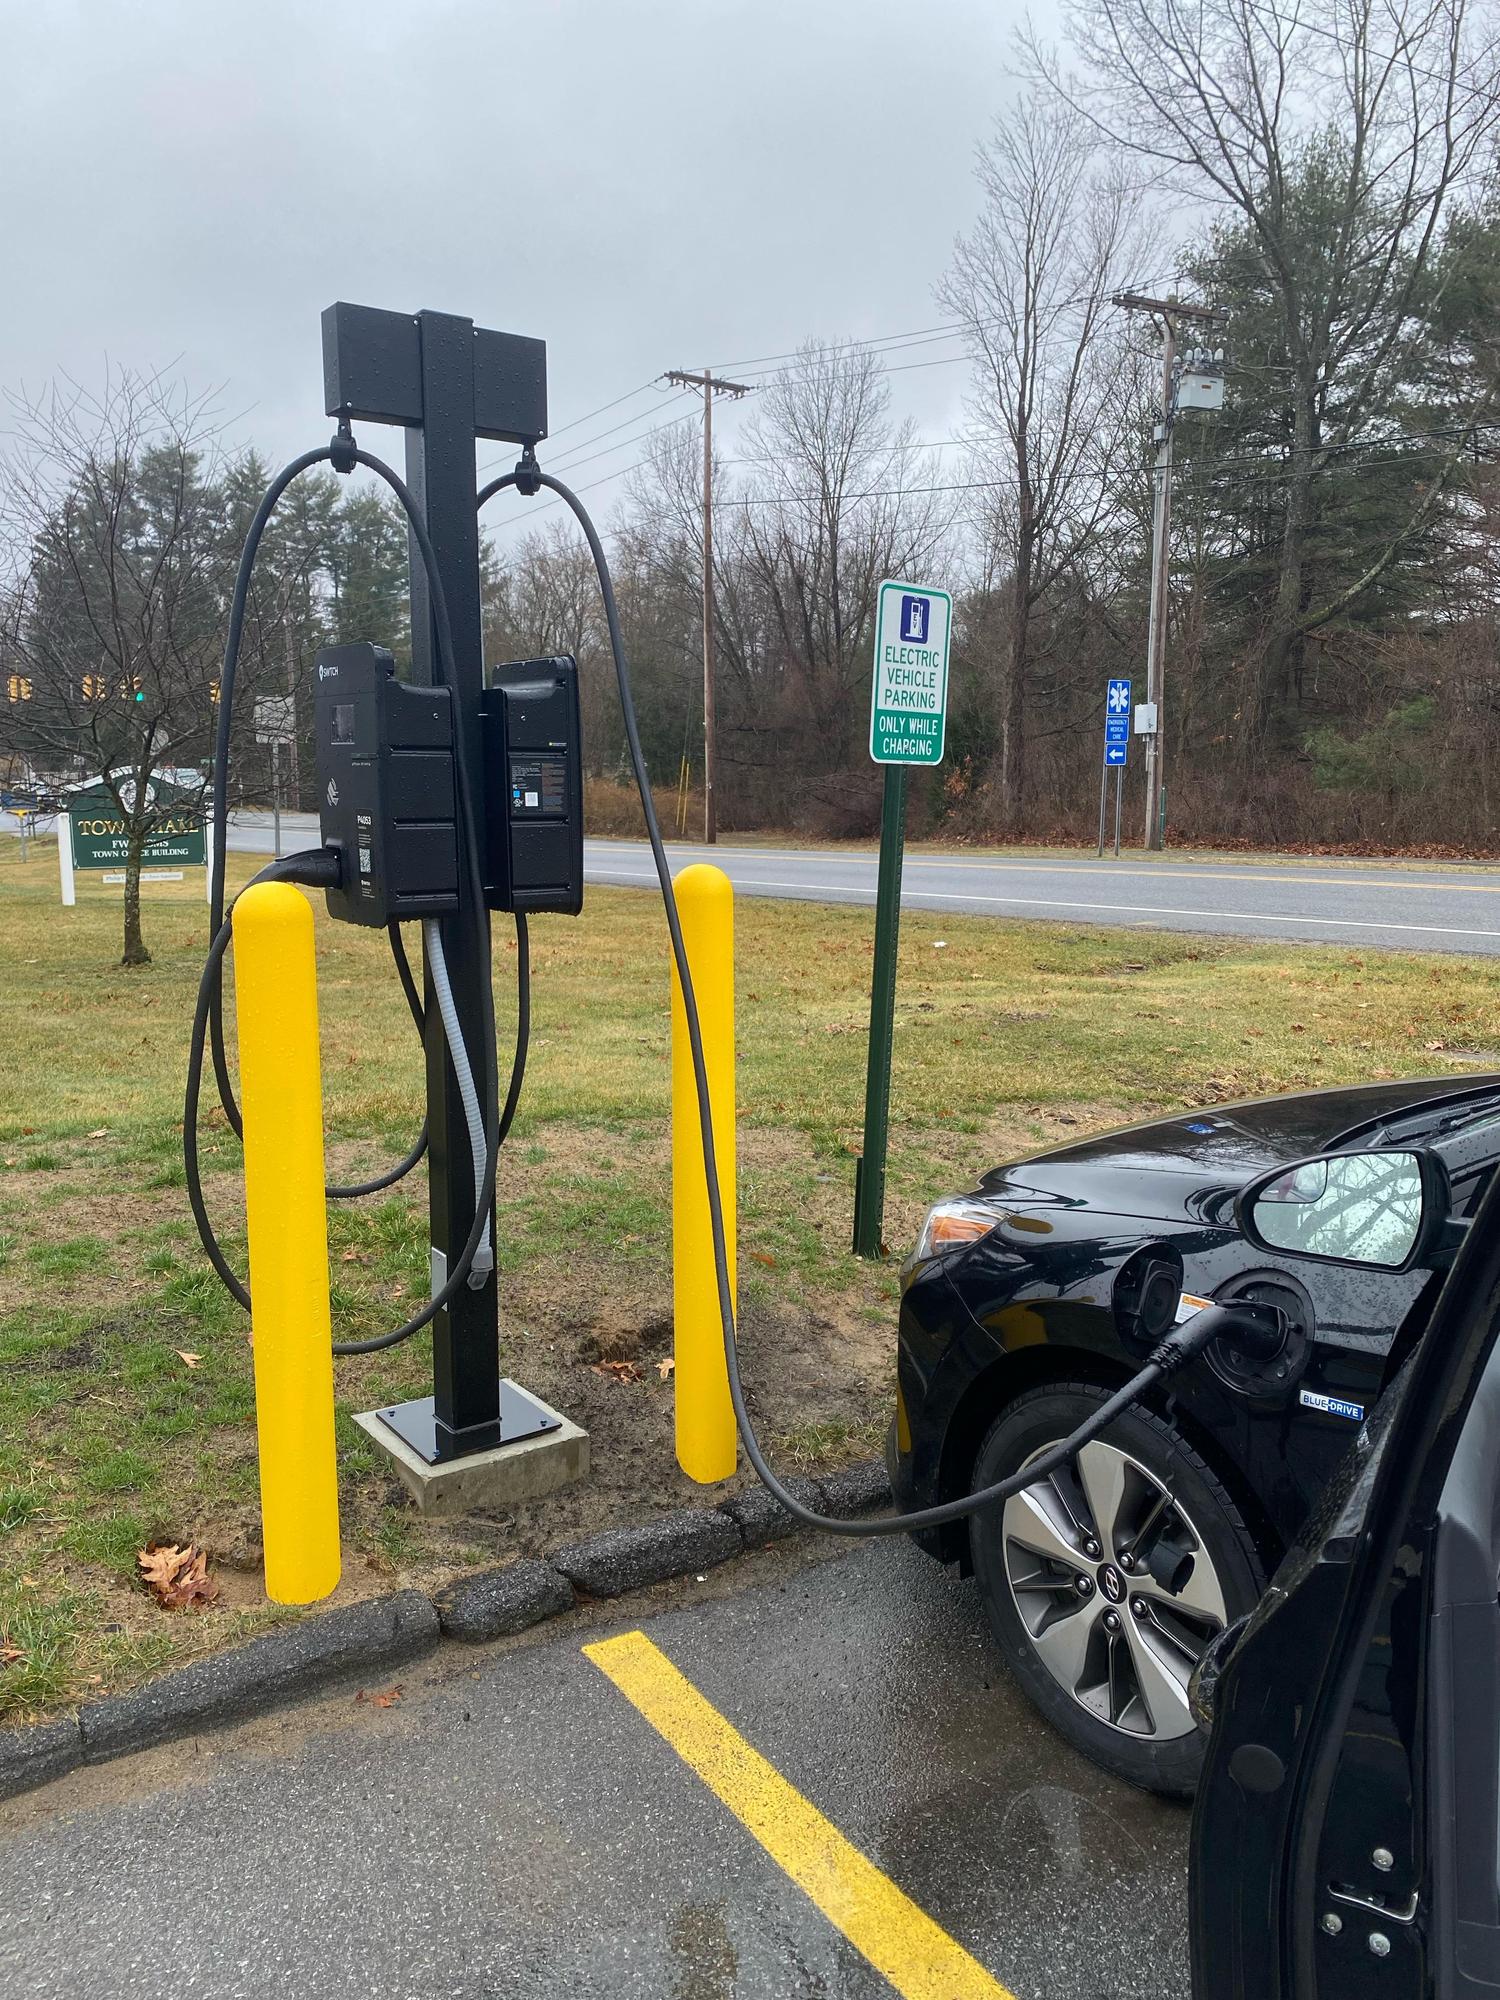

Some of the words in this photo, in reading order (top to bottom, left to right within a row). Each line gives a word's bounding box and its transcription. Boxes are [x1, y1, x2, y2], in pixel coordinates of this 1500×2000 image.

[885, 645, 940, 667] ELECTRIC
[887, 667, 936, 688] VEHICLE
[884, 688, 936, 709] PARKING
[879, 715, 906, 734] ONLY
[908, 717, 938, 736] WHILE
[883, 737, 932, 756] CHARGING
[92, 850, 119, 858] TOWN
[151, 848, 189, 857] BUILDING
